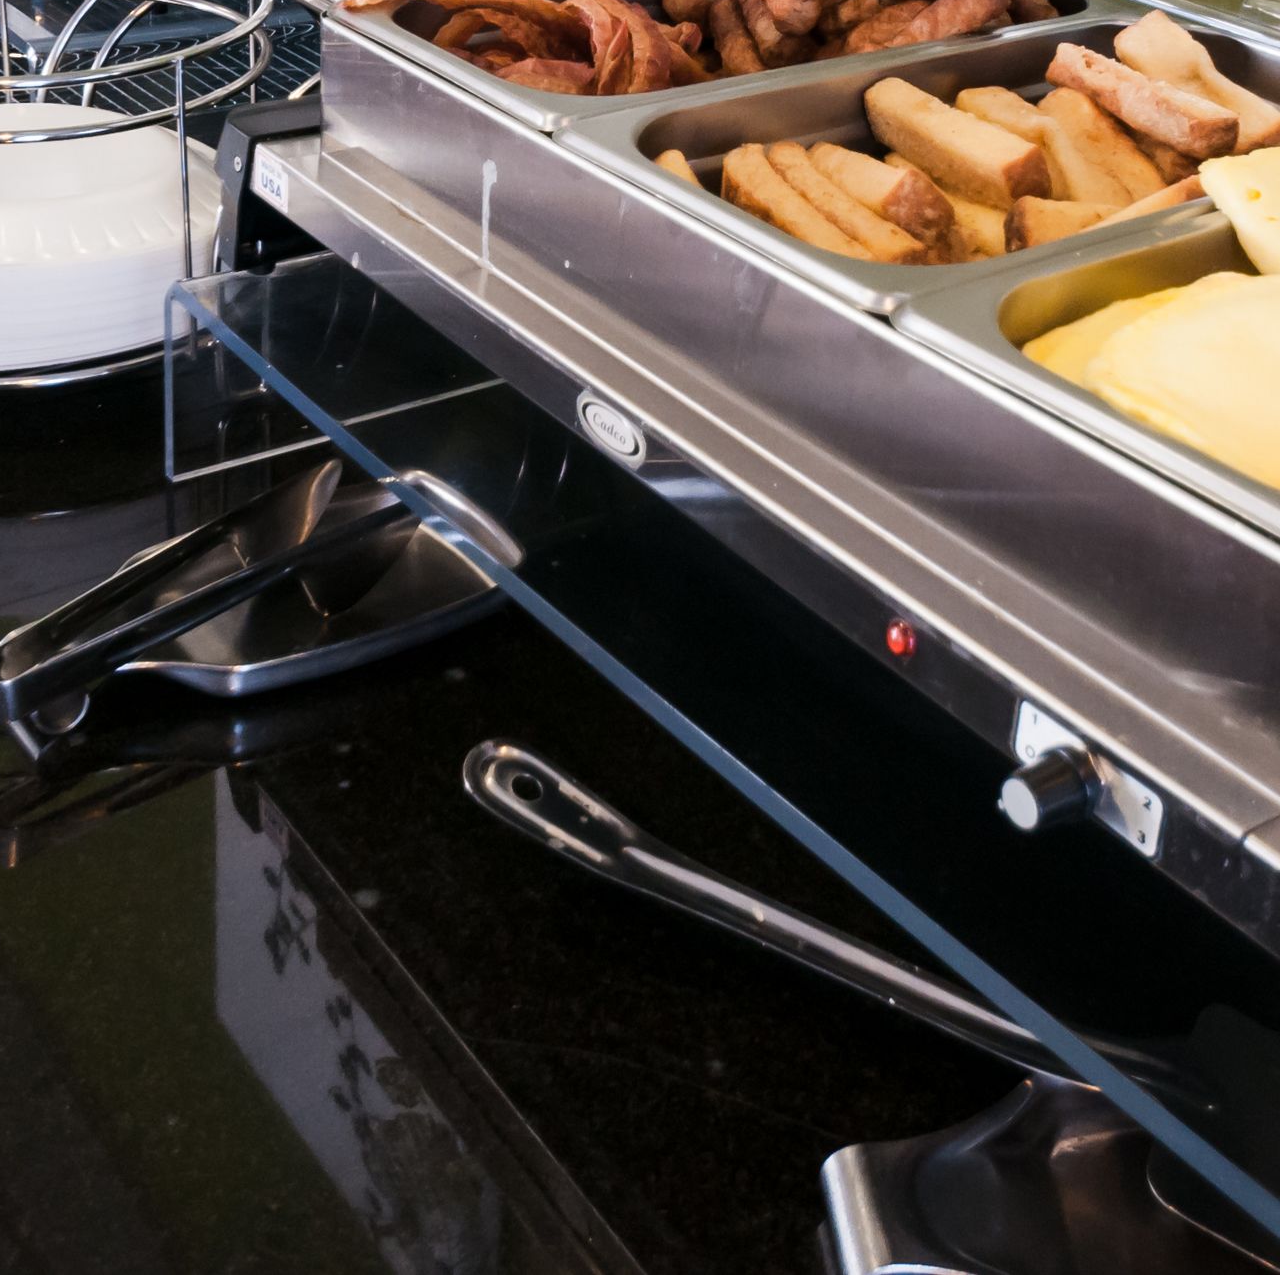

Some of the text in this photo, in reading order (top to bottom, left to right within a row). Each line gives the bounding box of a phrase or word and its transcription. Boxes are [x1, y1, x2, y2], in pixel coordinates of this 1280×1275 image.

[261, 172, 282, 199] USA
[593, 412, 626, 446] Cadco
[1143, 796, 1152, 811] 2
[1137, 830, 1146, 844] 3
